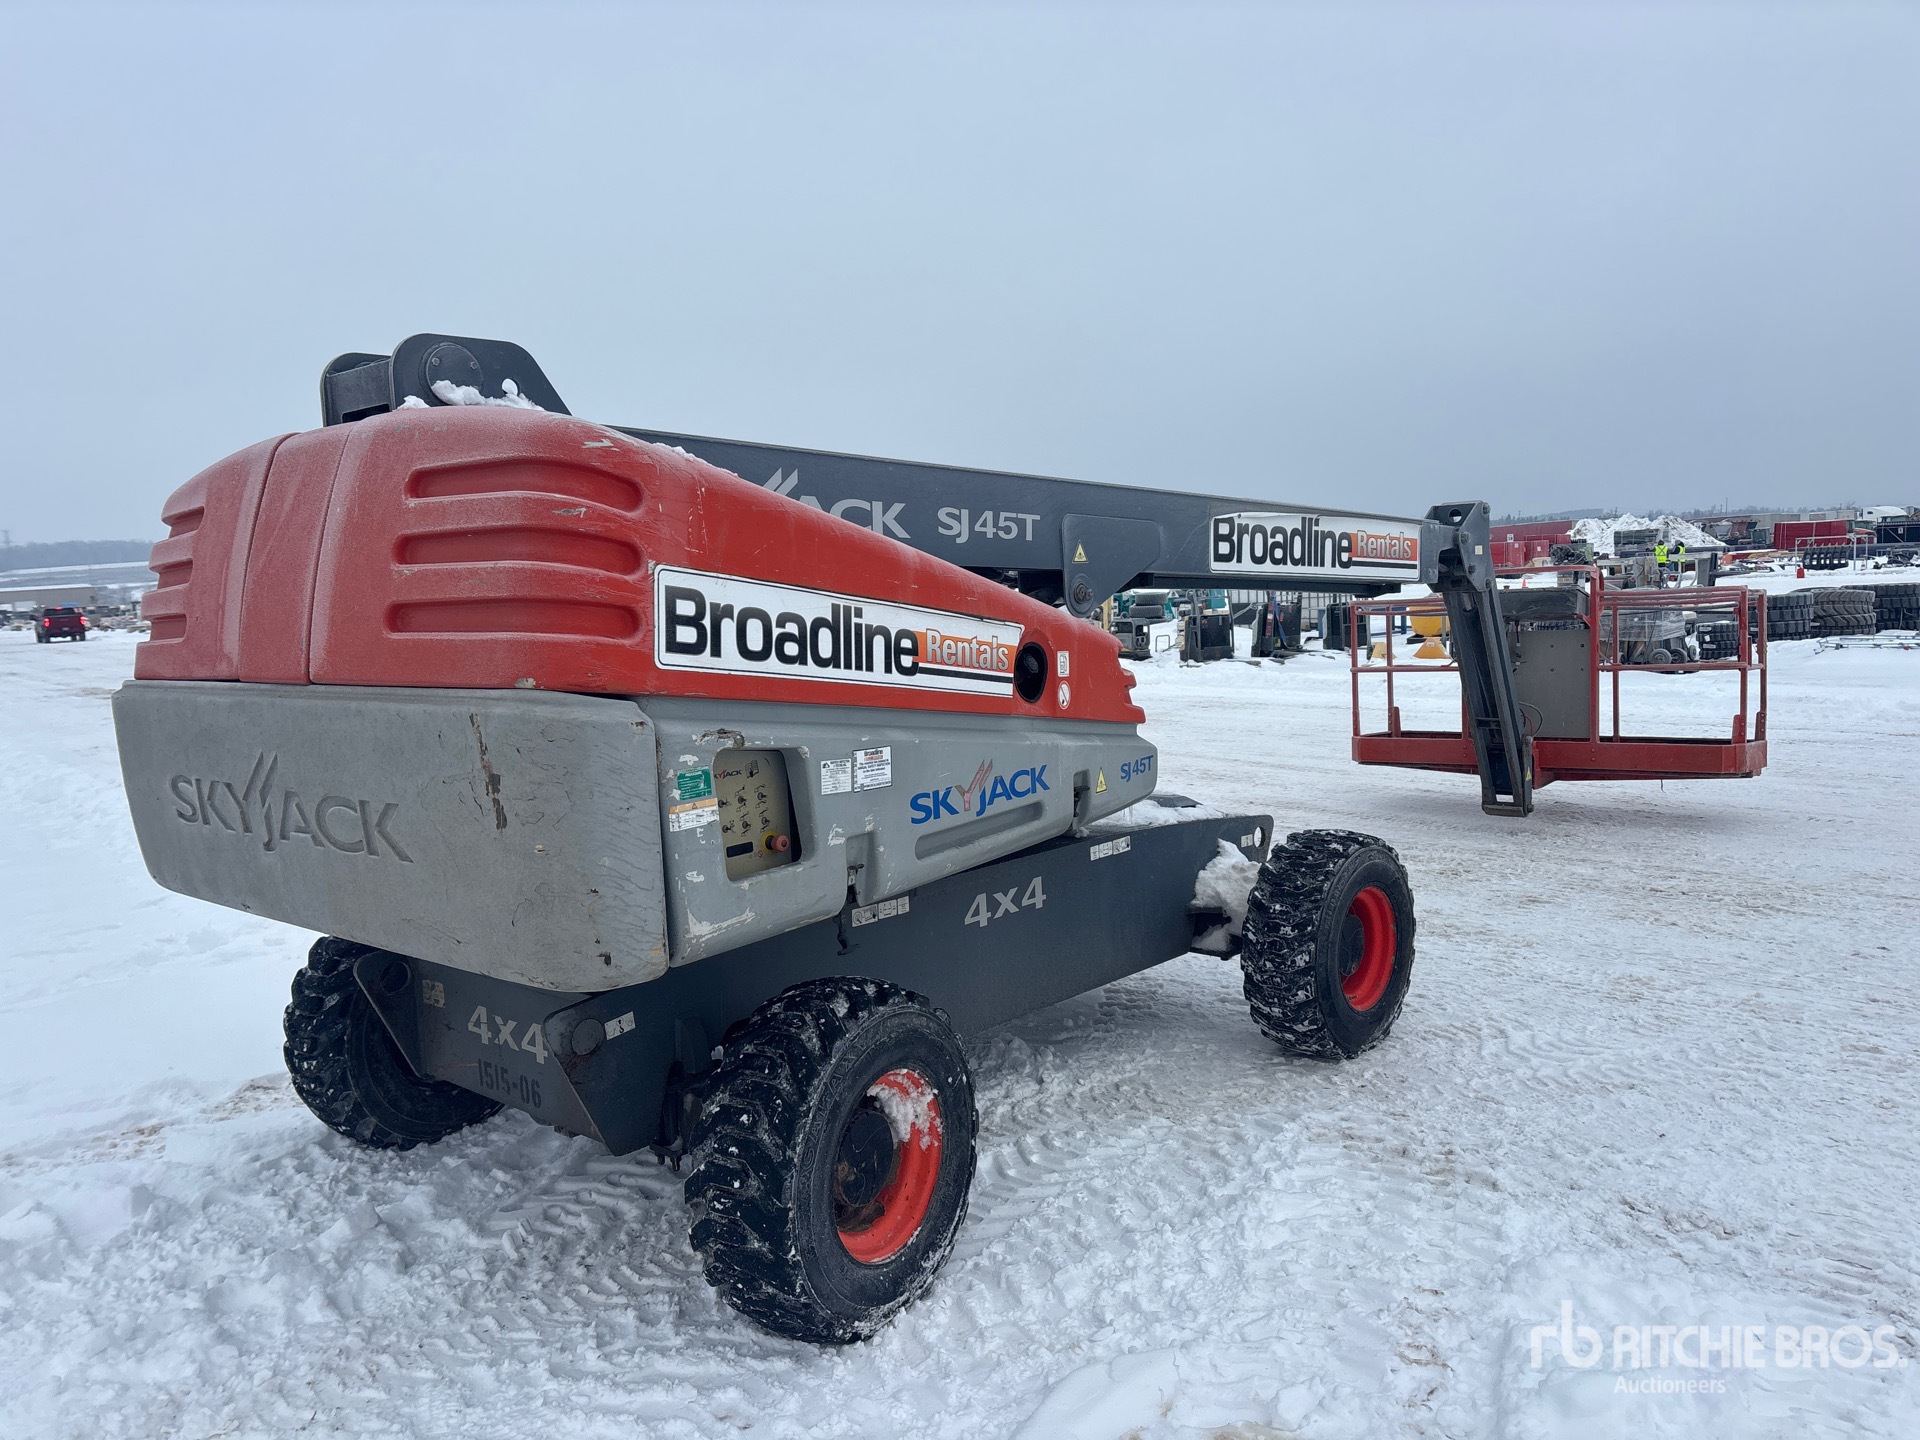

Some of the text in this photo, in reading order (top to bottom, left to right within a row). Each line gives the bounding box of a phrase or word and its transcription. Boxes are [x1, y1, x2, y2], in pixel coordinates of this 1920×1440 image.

[937, 506, 1041, 544] SJ45T
[1213, 516, 1412, 569] Broadline Rentals
[664, 585, 1009, 677] Broadline Rentals
[713, 769, 742, 779] KYJACK
[910, 758, 1051, 825] SKYJACK
[1120, 755, 1154, 783] SJ45T
[171, 750, 415, 864] SKYJACK
